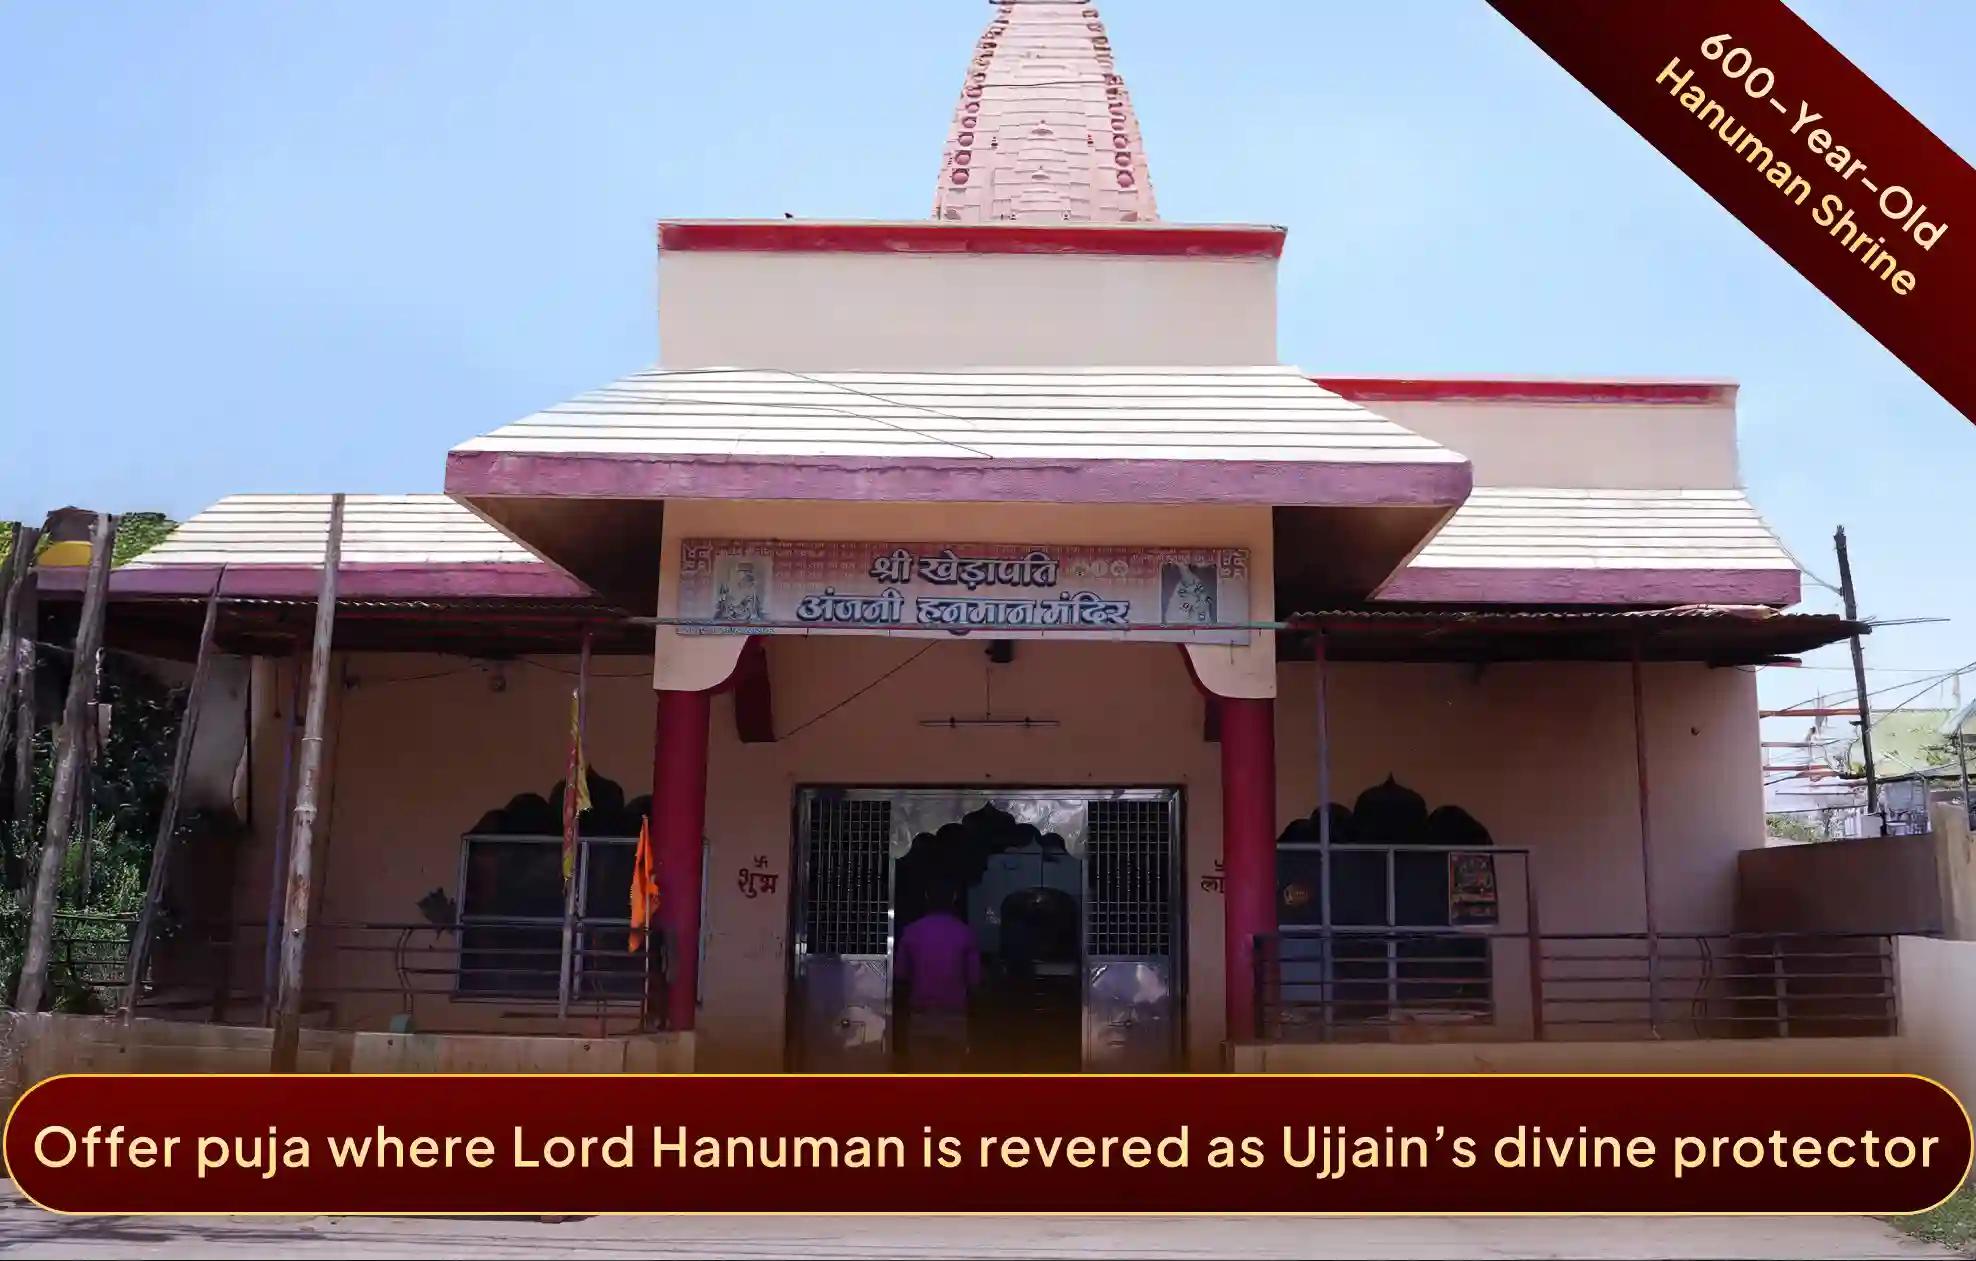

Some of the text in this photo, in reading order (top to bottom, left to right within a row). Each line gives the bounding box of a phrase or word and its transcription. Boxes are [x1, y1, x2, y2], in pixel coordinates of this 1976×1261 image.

[869, 548, 912, 584] श्री
[918, 549, 1059, 590] खेड़ापति
[797, 586, 1130, 636] अंजनी हनुमान मंदिर
